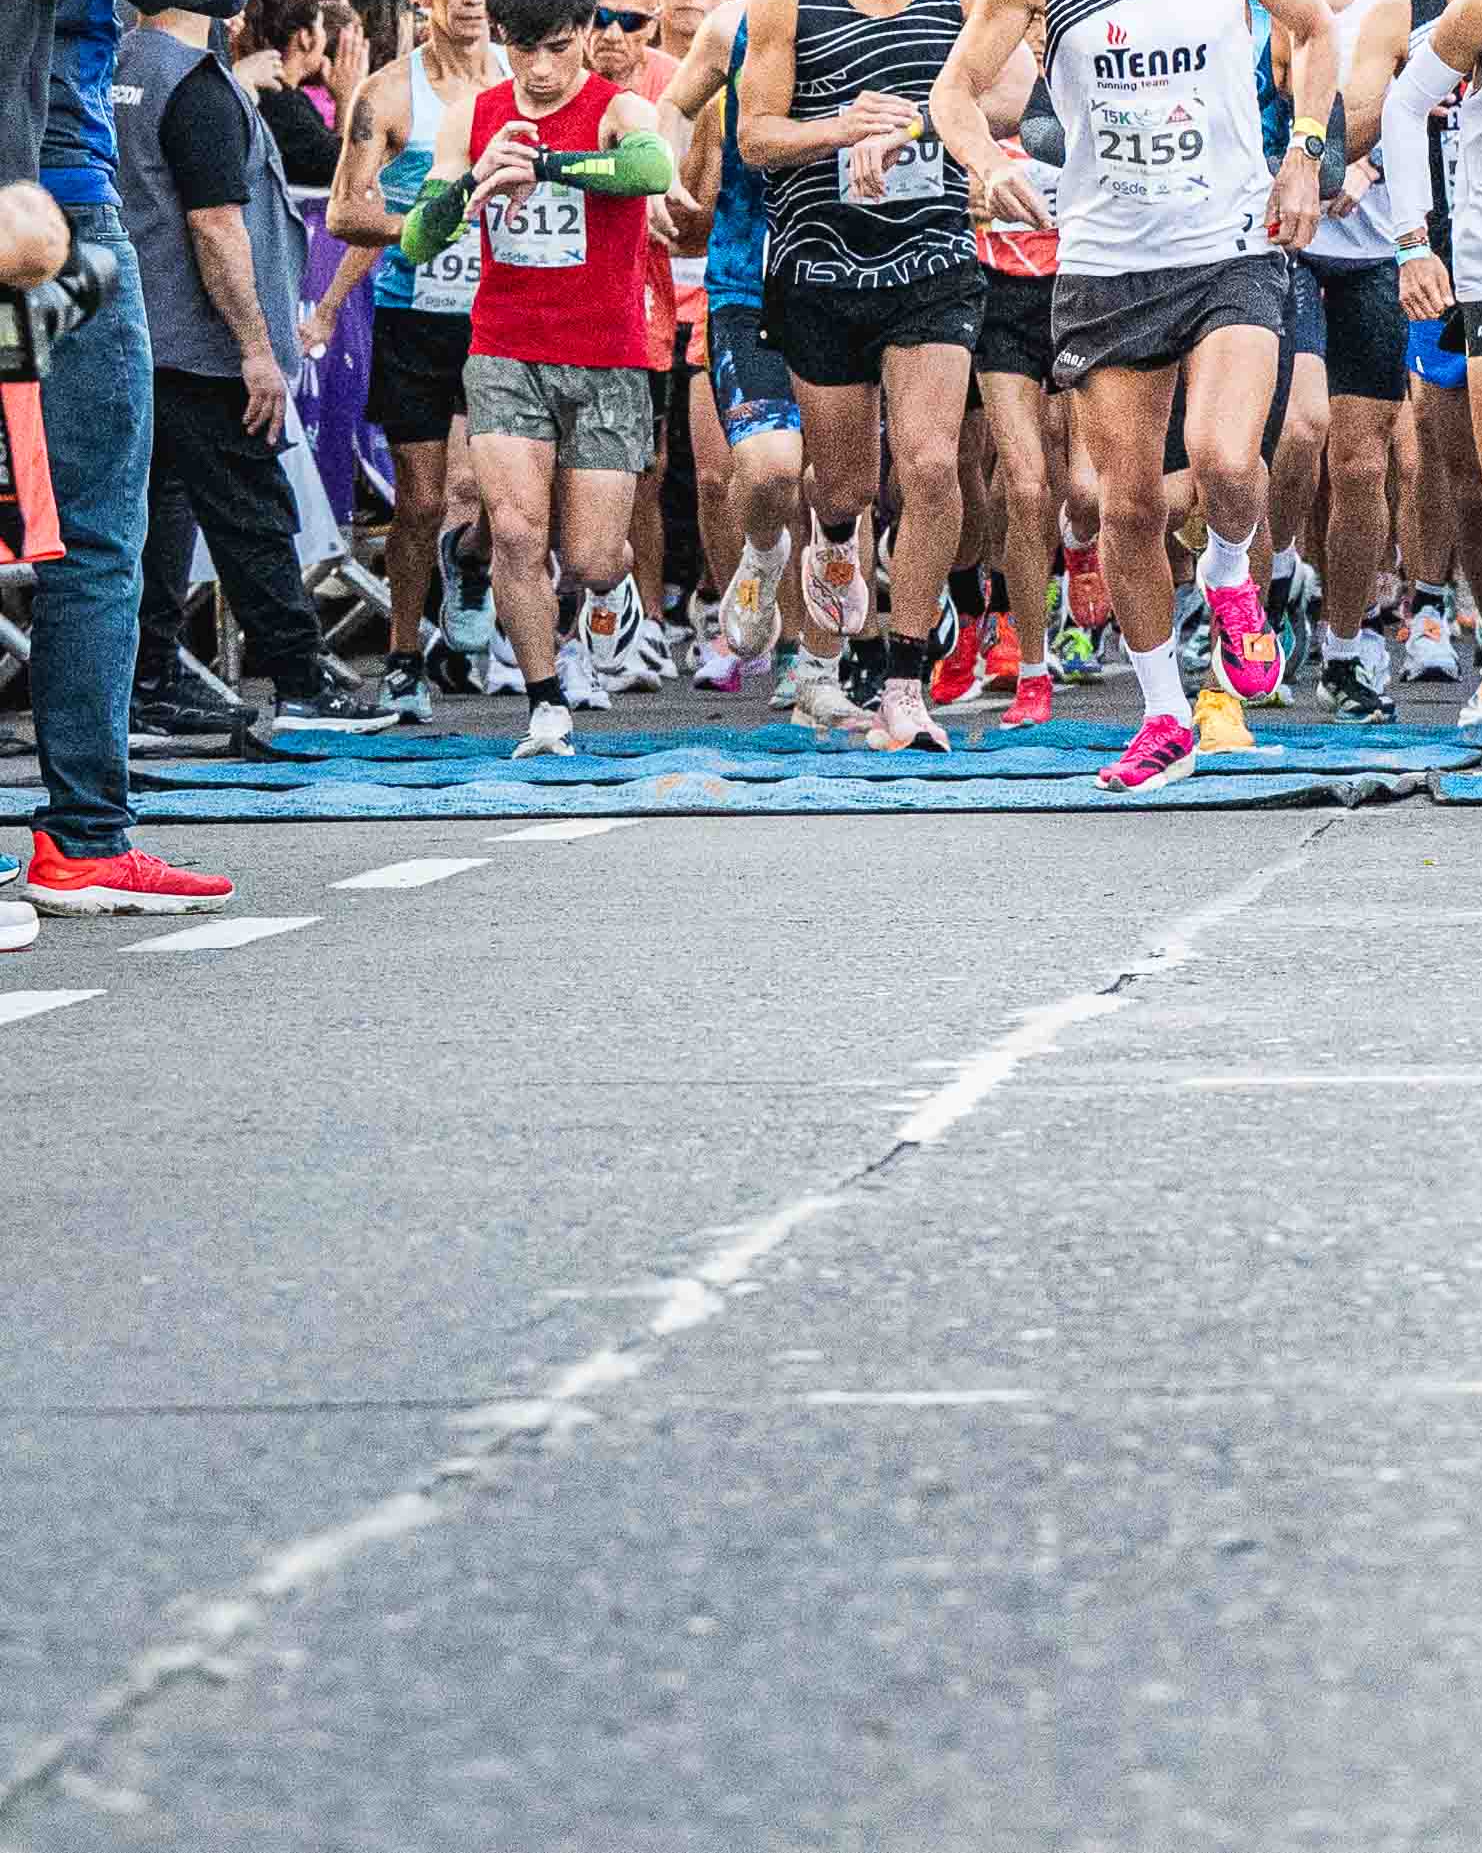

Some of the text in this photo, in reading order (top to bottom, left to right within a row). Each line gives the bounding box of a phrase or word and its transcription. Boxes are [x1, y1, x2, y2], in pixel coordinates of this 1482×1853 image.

[1093, 43, 1207, 80] ATENAS
[1097, 78, 1169, 92] running team
[1101, 108, 1132, 125] 15K
[1097, 128, 1205, 166] 2159
